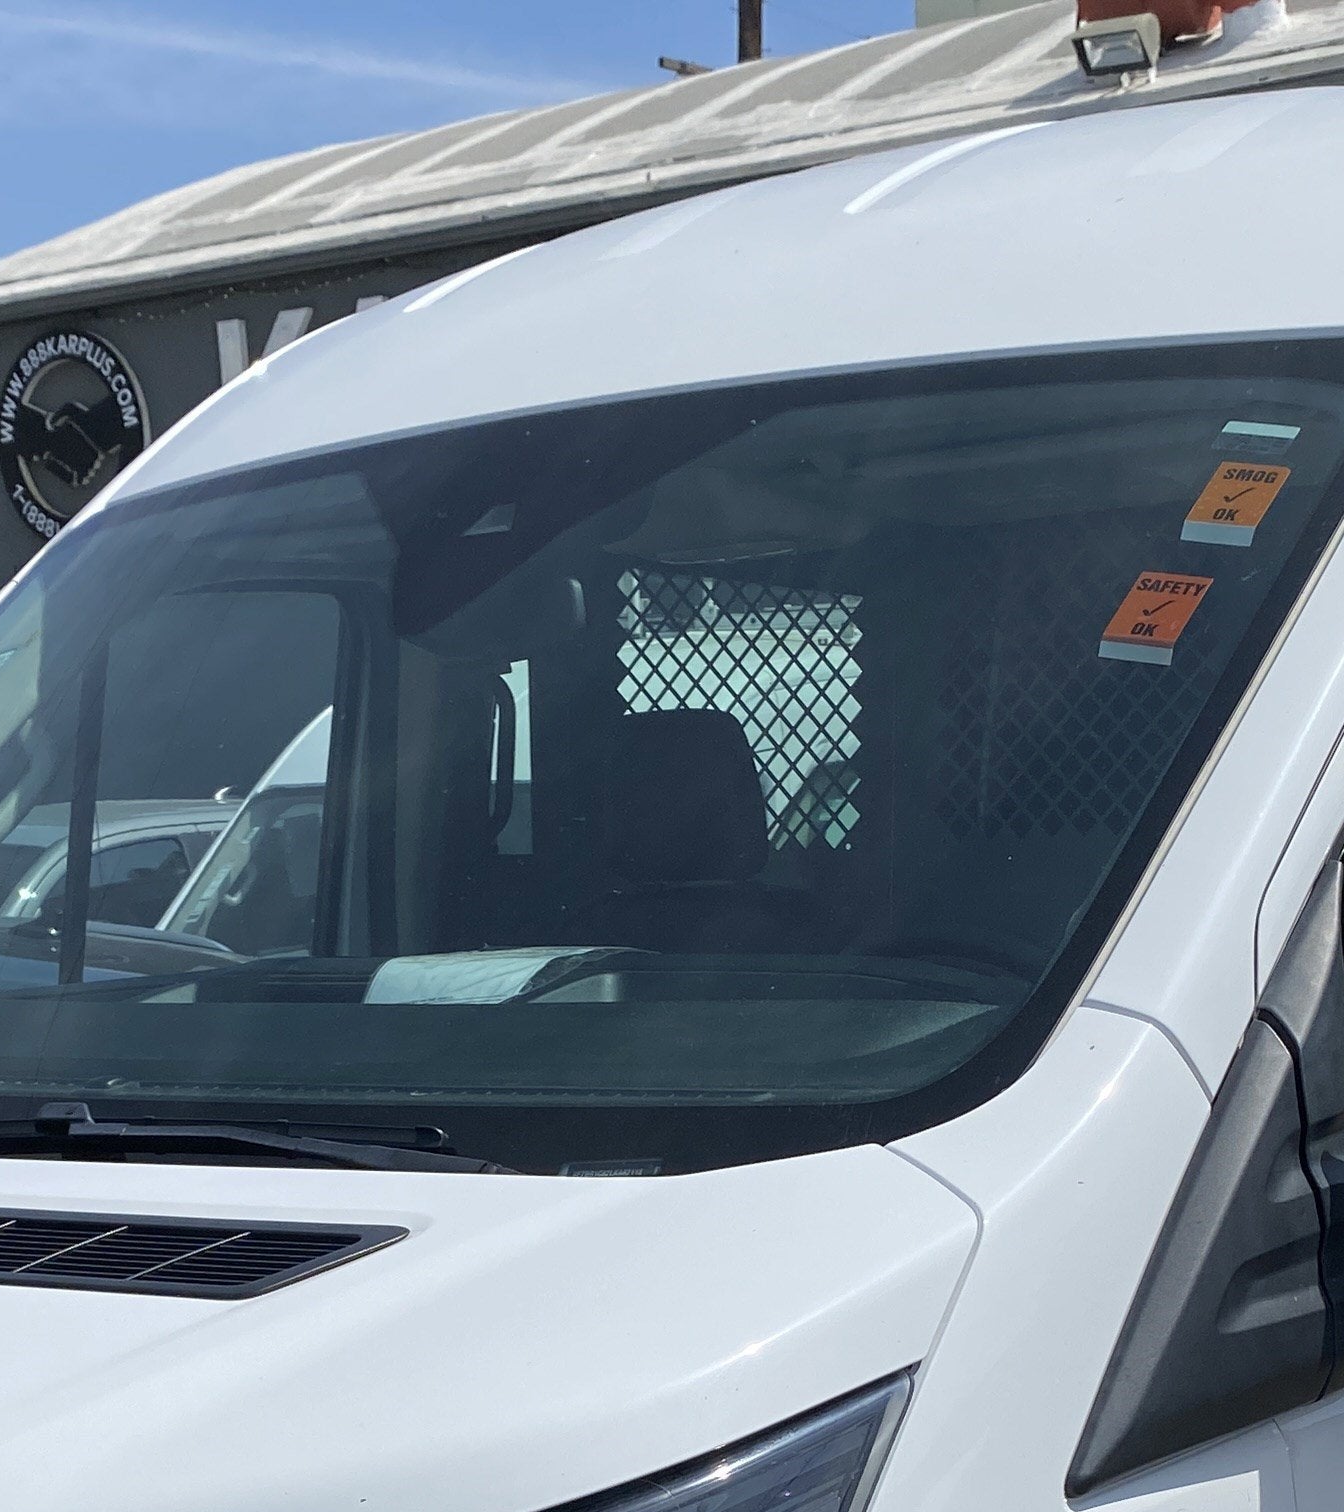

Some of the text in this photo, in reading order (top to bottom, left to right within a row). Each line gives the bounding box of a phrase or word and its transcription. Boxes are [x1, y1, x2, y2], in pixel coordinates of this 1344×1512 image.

[0, 334, 139, 443] WWW.888KARPLUS.COM
[1223, 468, 1278, 484] SMOG
[1212, 508, 1240, 521] OK
[1136, 578, 1206, 597] SAFETY
[1130, 622, 1159, 637] OK
